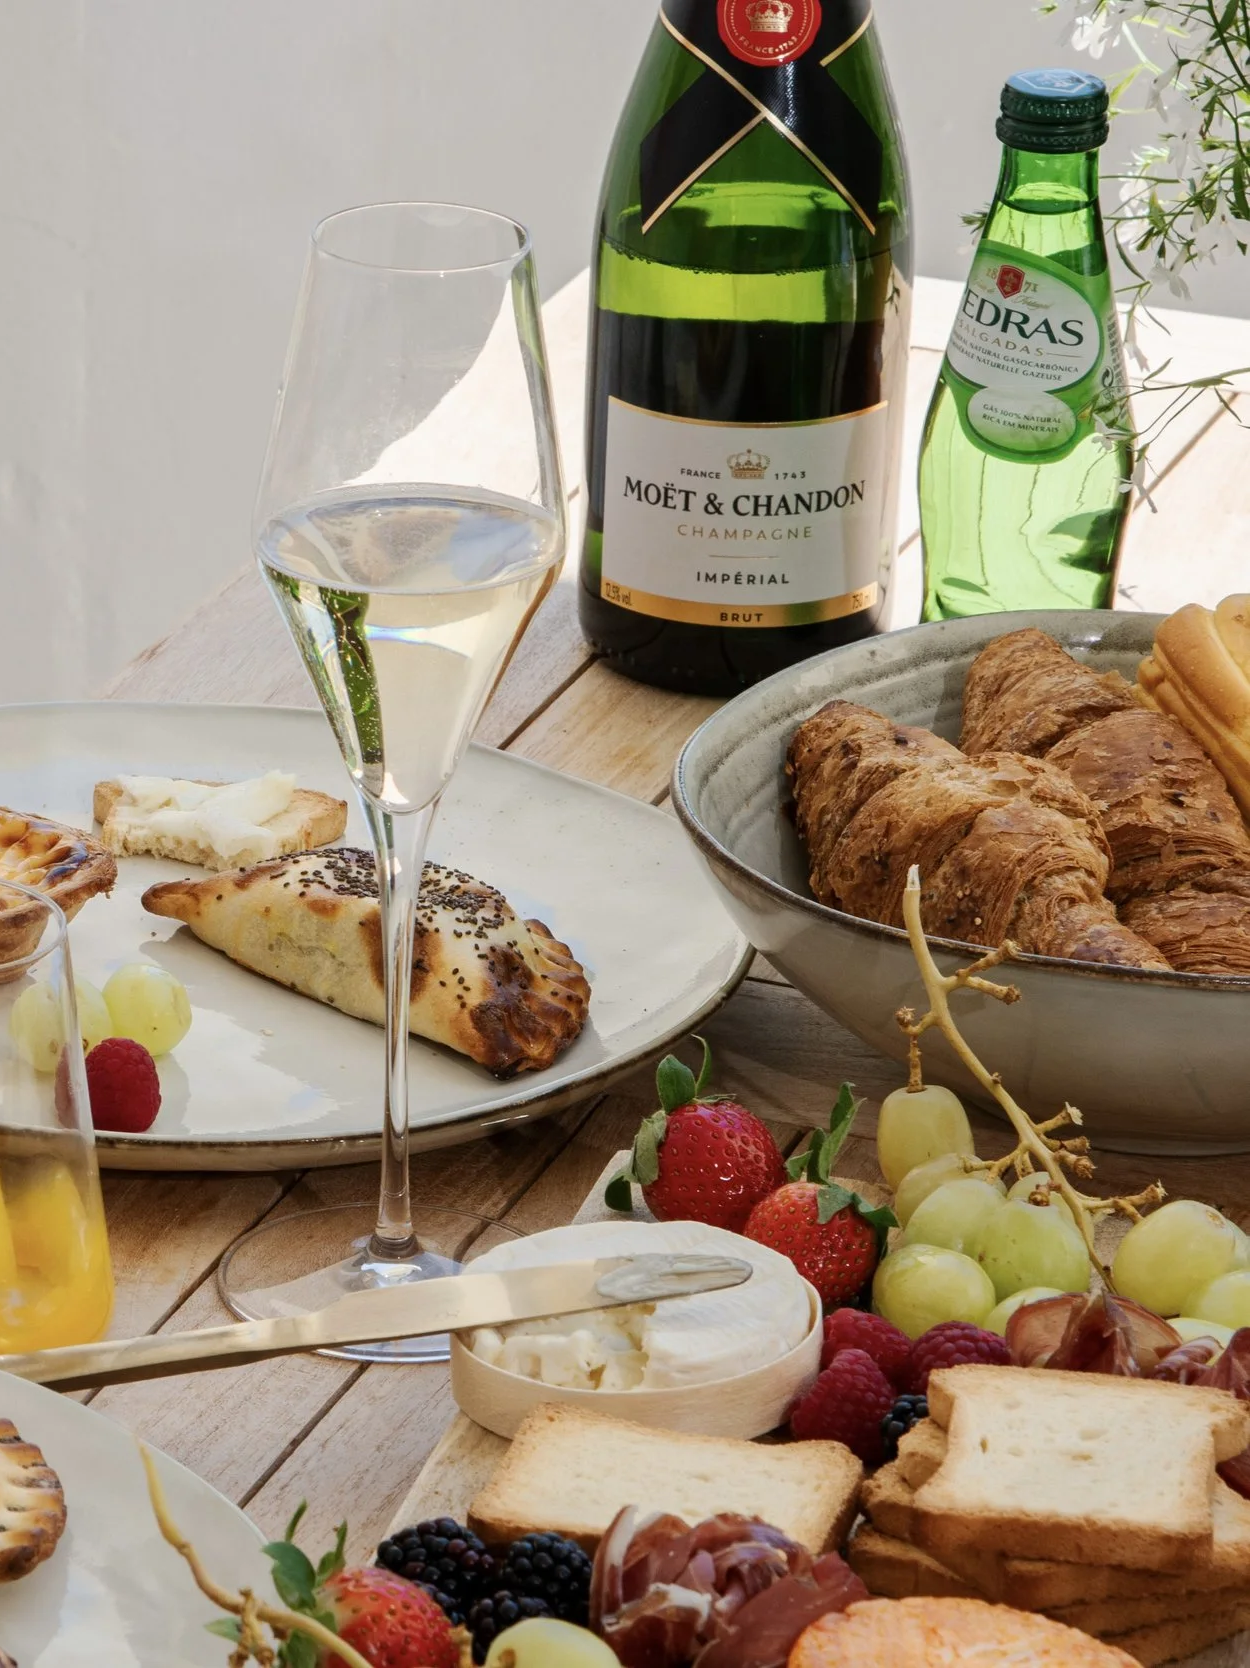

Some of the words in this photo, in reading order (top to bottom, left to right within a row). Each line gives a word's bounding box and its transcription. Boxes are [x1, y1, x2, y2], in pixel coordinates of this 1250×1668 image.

[739, 36, 774, 54] FRANCE
[962, 287, 1084, 347] EDRAS
[958, 319, 1045, 357] SALGADAS
[969, 341, 1001, 359] NATURAL
[1022, 369, 1063, 381] GAZEUSE
[982, 412, 1001, 425] RICA
[1002, 420, 1016, 429] EM
[1017, 423, 1060, 433] MINERAIS
[1000, 409, 1021, 420] 100%
[1023, 414, 1062, 424] NATURAL
[680, 468, 721, 480] FRANCE
[775, 471, 806, 481] 1743
[623, 476, 697, 513] MOËT
[703, 492, 724, 515] &
[732, 479, 866, 517] CHANDON
[677, 523, 813, 541] CHAMPAGNE
[696, 570, 790, 586] IMPÉRIAL
[720, 612, 764, 623] BRUT
